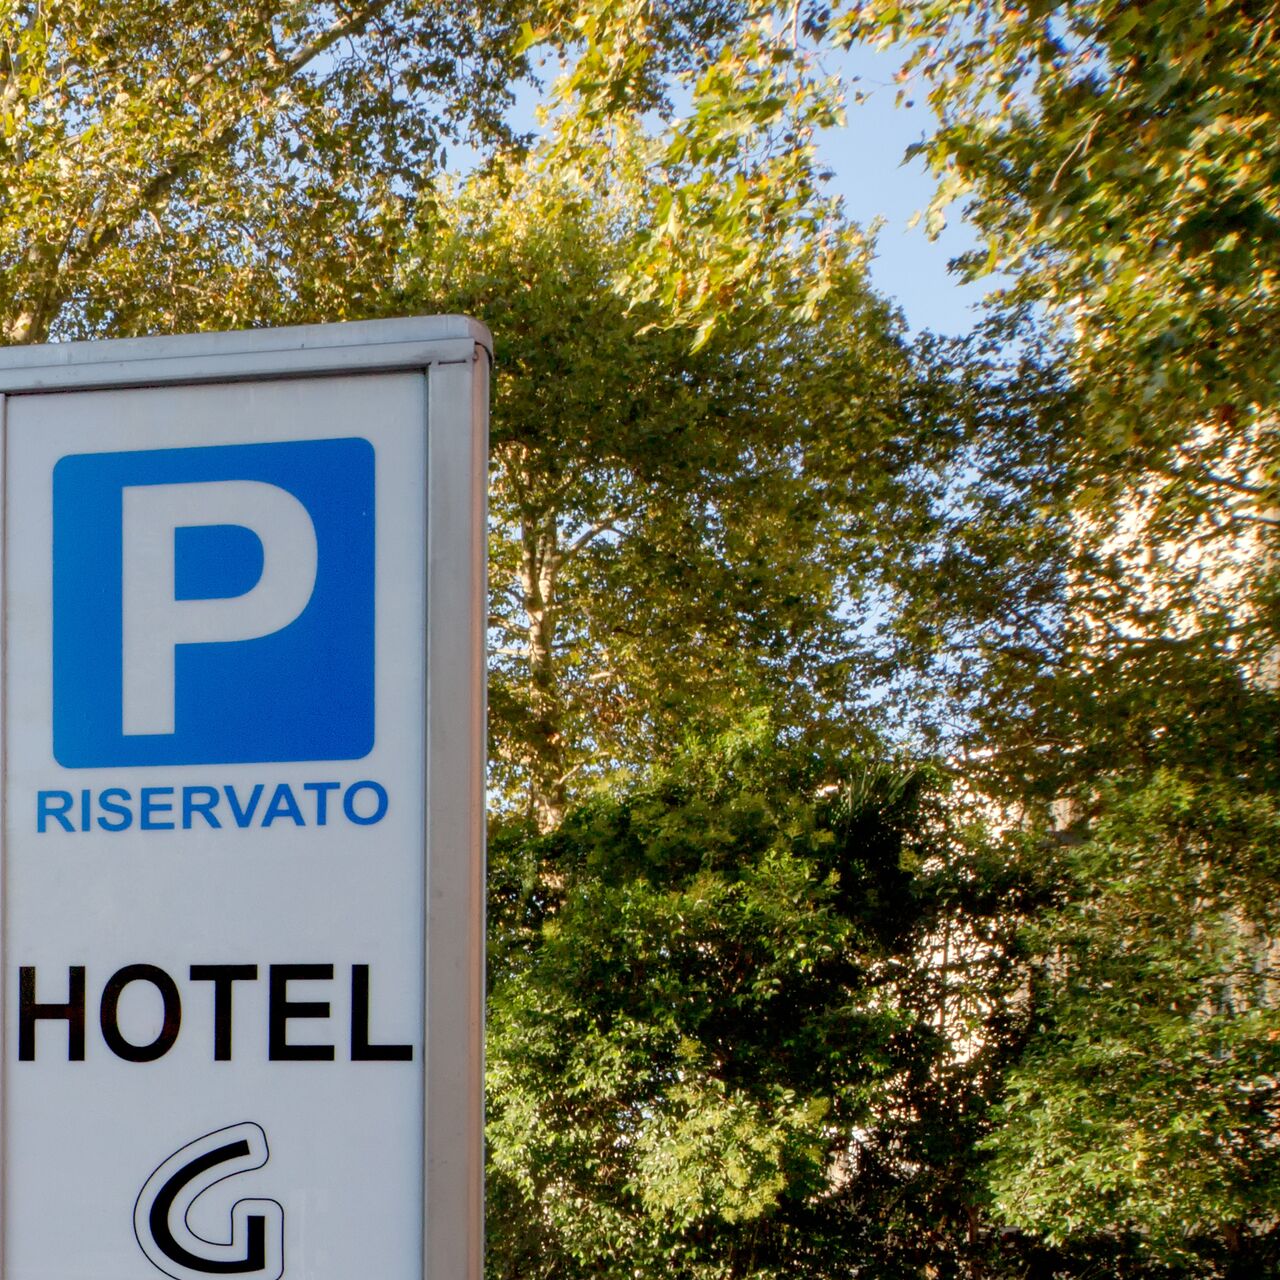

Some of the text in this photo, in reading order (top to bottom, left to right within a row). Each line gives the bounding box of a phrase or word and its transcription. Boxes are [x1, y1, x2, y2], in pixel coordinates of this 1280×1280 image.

[122, 479, 318, 736] P
[37, 780, 389, 834] RISERVATO
[18, 963, 413, 1063] HOTEL
